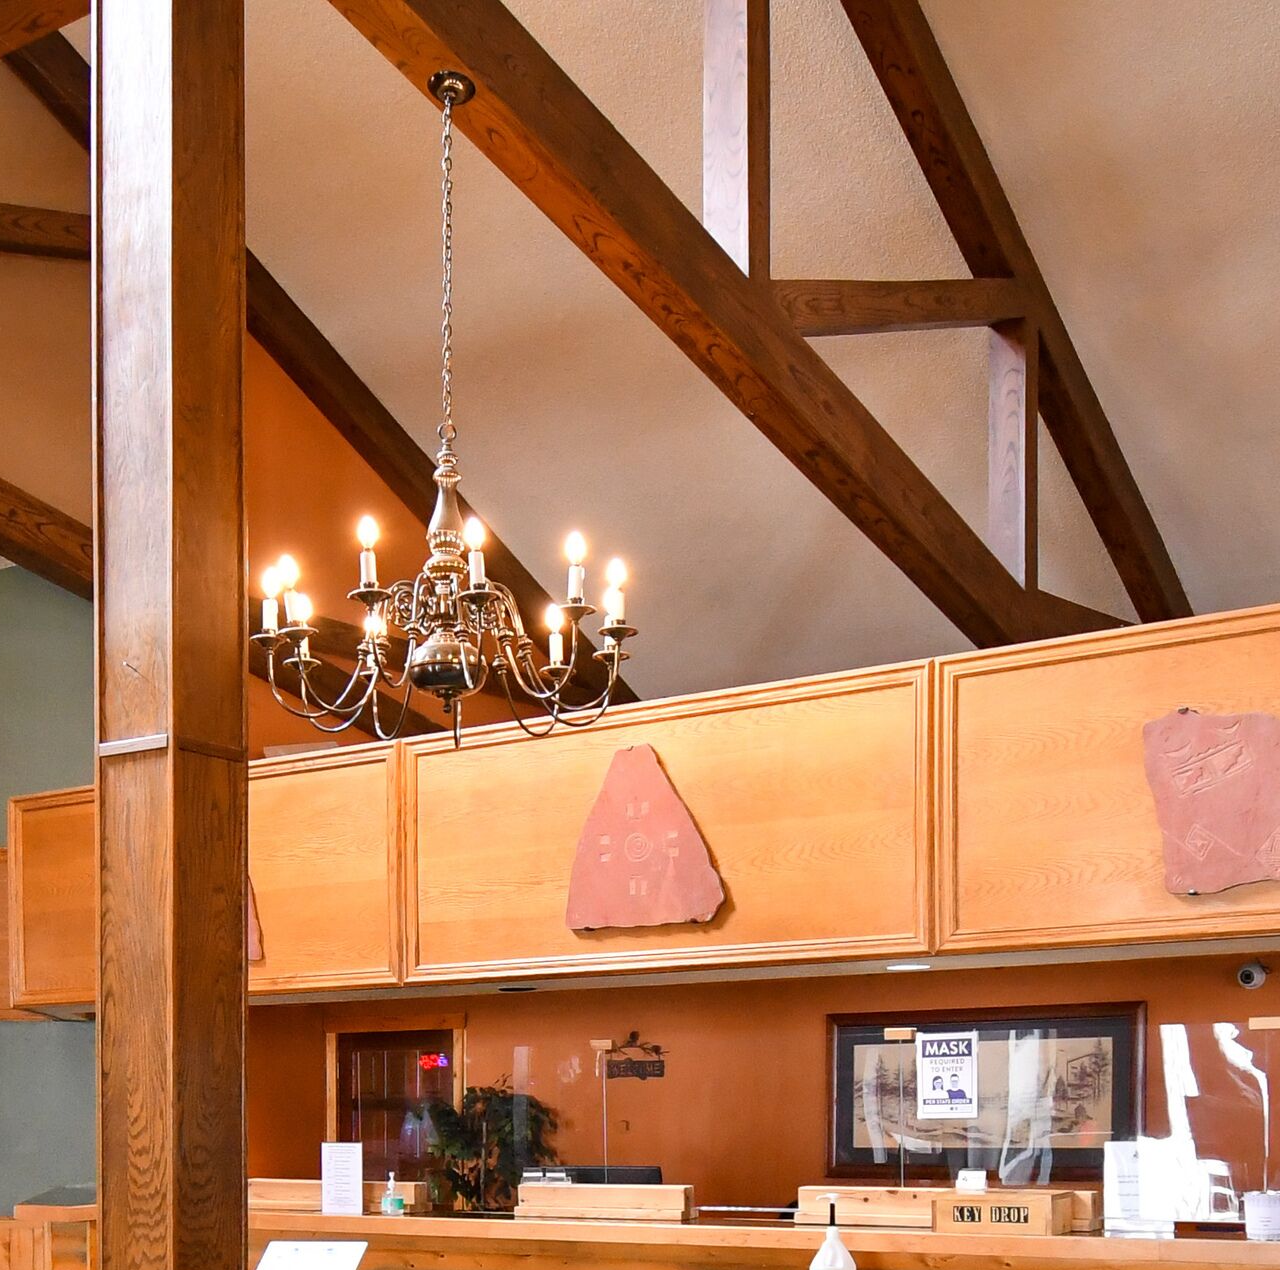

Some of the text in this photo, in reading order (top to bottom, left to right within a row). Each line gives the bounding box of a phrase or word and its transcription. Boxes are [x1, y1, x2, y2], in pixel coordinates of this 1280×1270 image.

[925, 1040, 969, 1056] MASK
[954, 1206, 1028, 1223] KEY DROP
